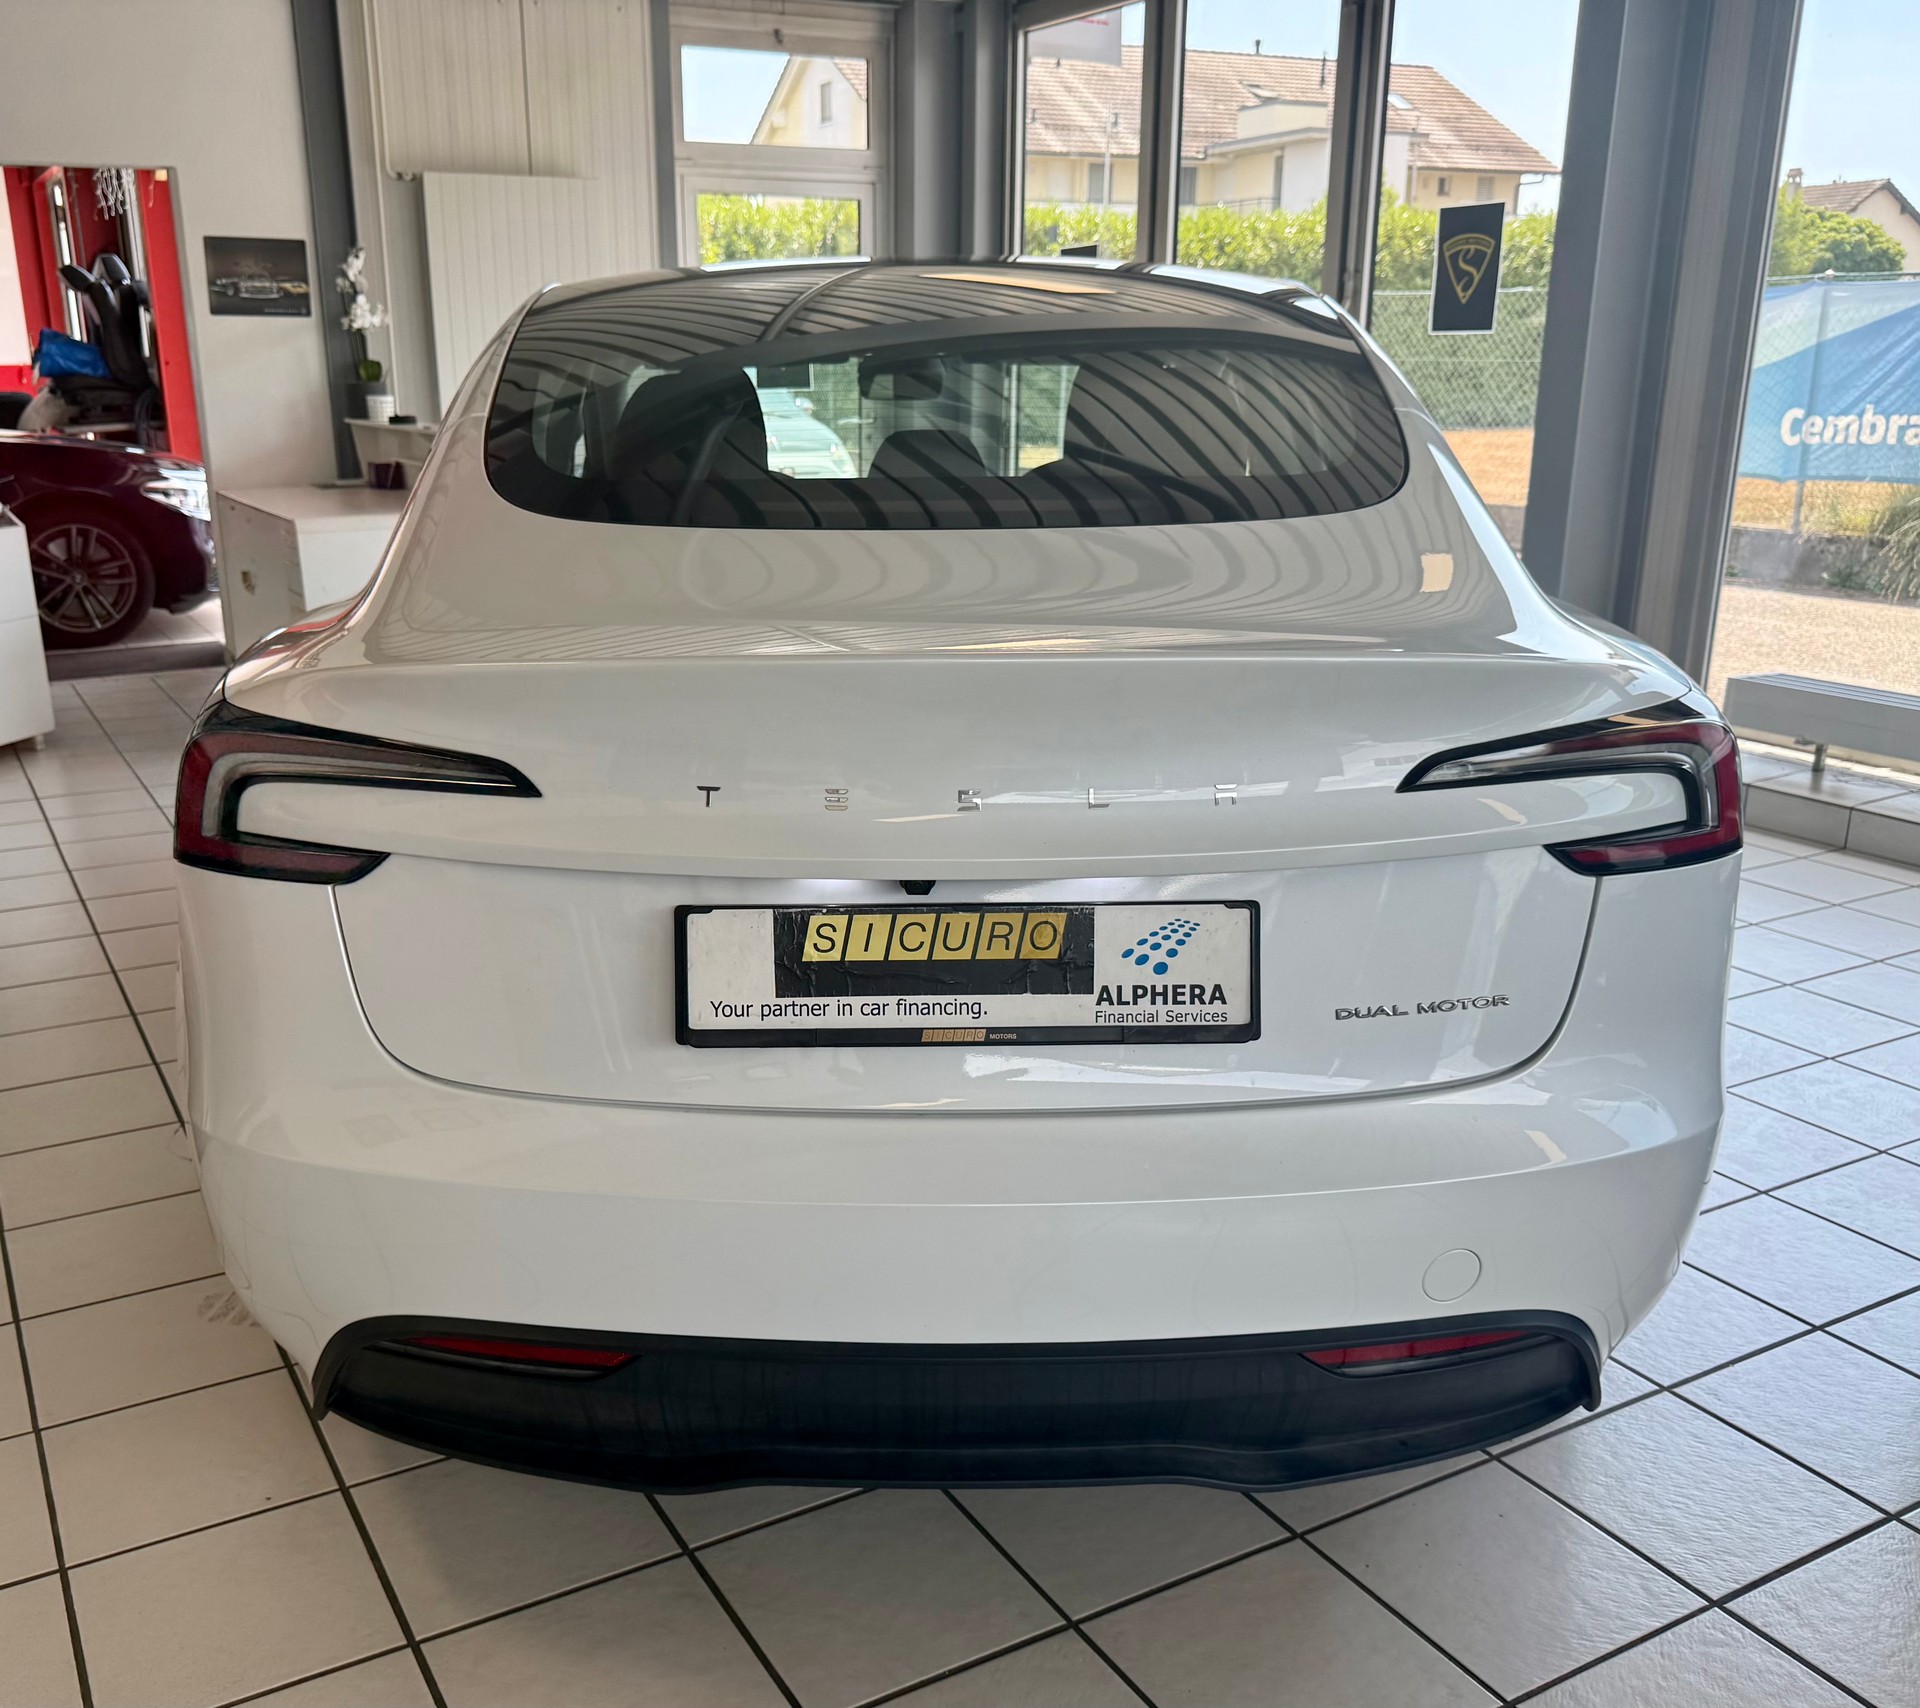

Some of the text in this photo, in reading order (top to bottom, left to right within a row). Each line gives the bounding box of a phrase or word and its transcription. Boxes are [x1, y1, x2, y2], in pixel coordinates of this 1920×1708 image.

[1780, 403, 1920, 446] Cembra
[696, 783, 1237, 812] TESLA
[812, 920, 1058, 953] SICURO
[1095, 984, 1228, 1006] ALPHERA
[710, 998, 989, 1021] Your partner in car financing.
[1095, 1009, 1228, 1024] Financial Services
[1335, 995, 1510, 1020] DUAL MOTOR
[922, 1029, 986, 1041] SICURO
